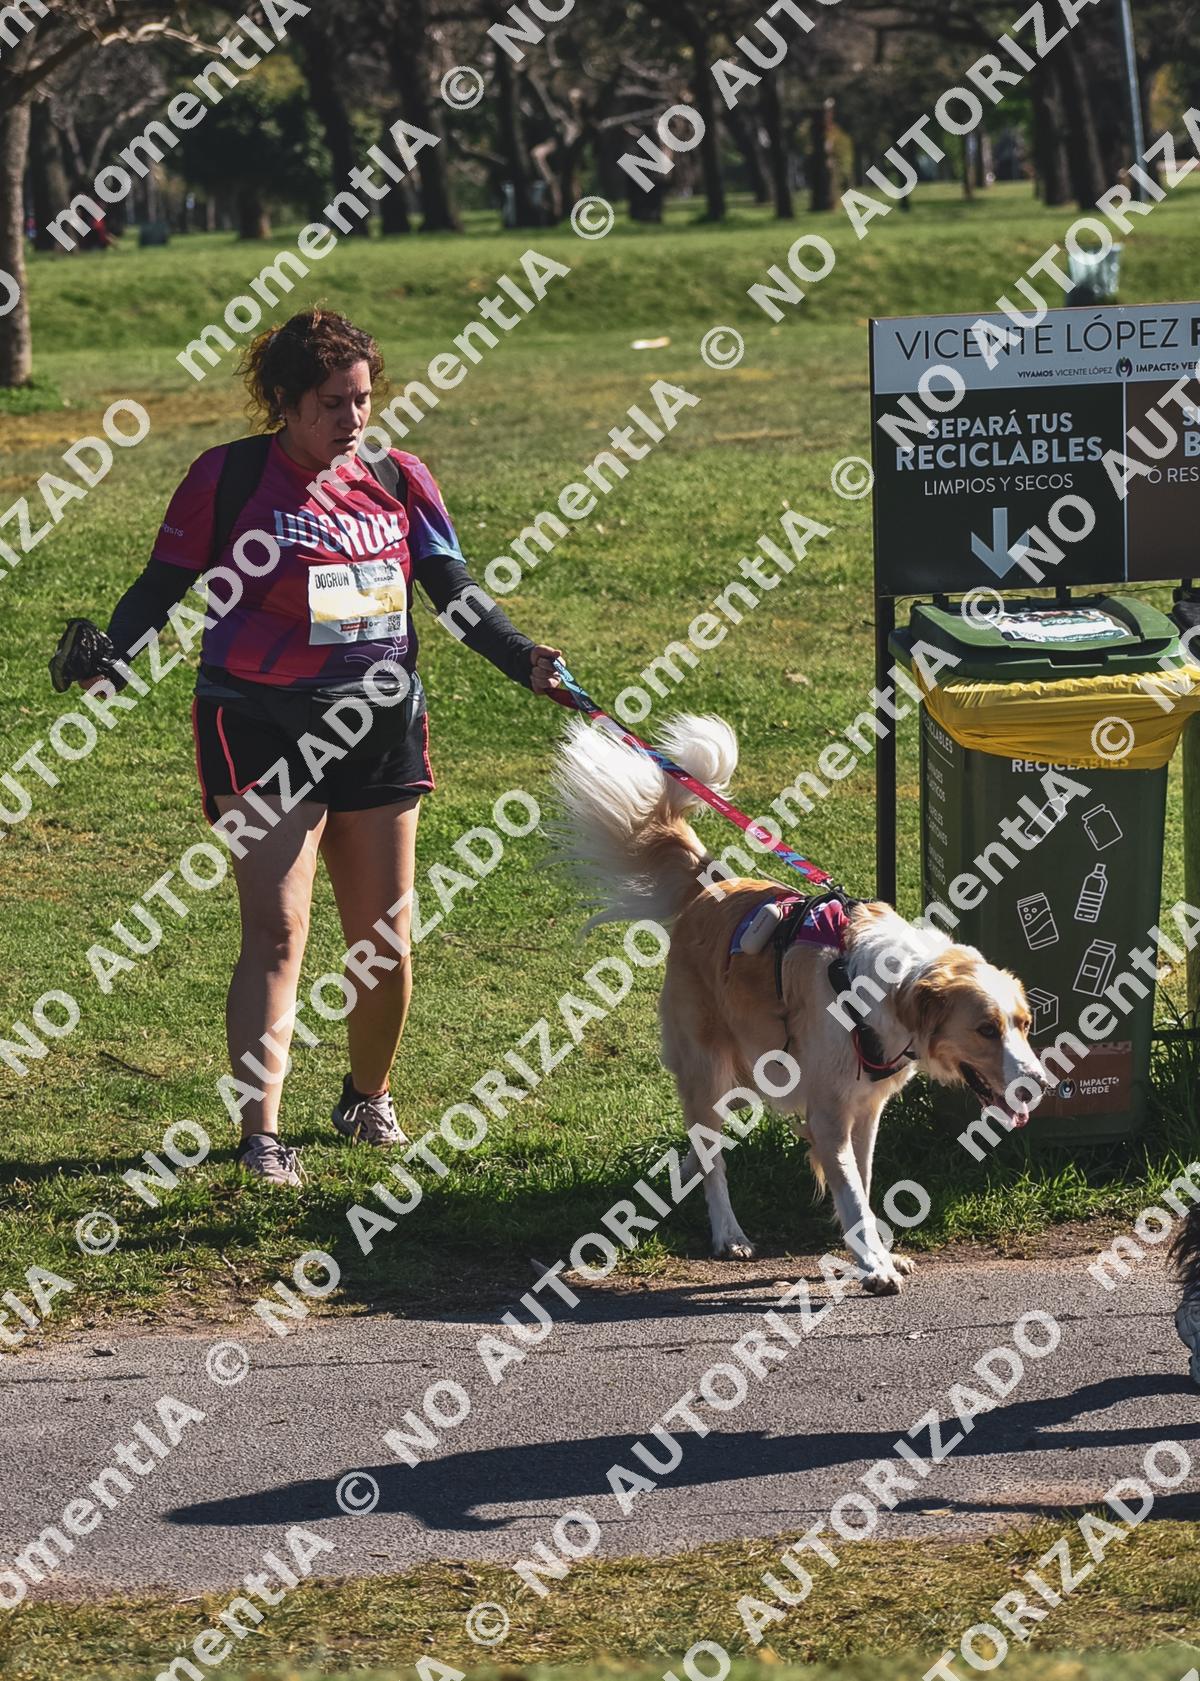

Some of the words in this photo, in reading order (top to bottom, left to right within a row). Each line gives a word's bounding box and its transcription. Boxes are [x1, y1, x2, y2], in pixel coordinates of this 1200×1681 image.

[895, 325, 1053, 360] VICENTE
[1066, 314, 1179, 351] LÓPEZ
[1017, 370, 1054, 379] VIVAMOS
[1056, 368, 1087, 377] VICENTE
[1089, 365, 1112, 375] LÓPEZ
[1136, 362, 1179, 373] IMPACTO
[926, 409, 1020, 440] SEPARÁ
[1028, 412, 1073, 434] TUS
[896, 436, 1102, 471] RECICLABLES
[1167, 466, 1199, 483] RES
[924, 477, 996, 496] LIMPIOS
[1000, 476, 1012, 491] Y
[1015, 473, 1074, 491] SECOS
[273, 509, 403, 557] DOGRUN
[315, 572, 350, 590] DOGRUN
[1080, 1077, 1119, 1087] IMPACTO
[1080, 1086, 1110, 1095] VERDE
